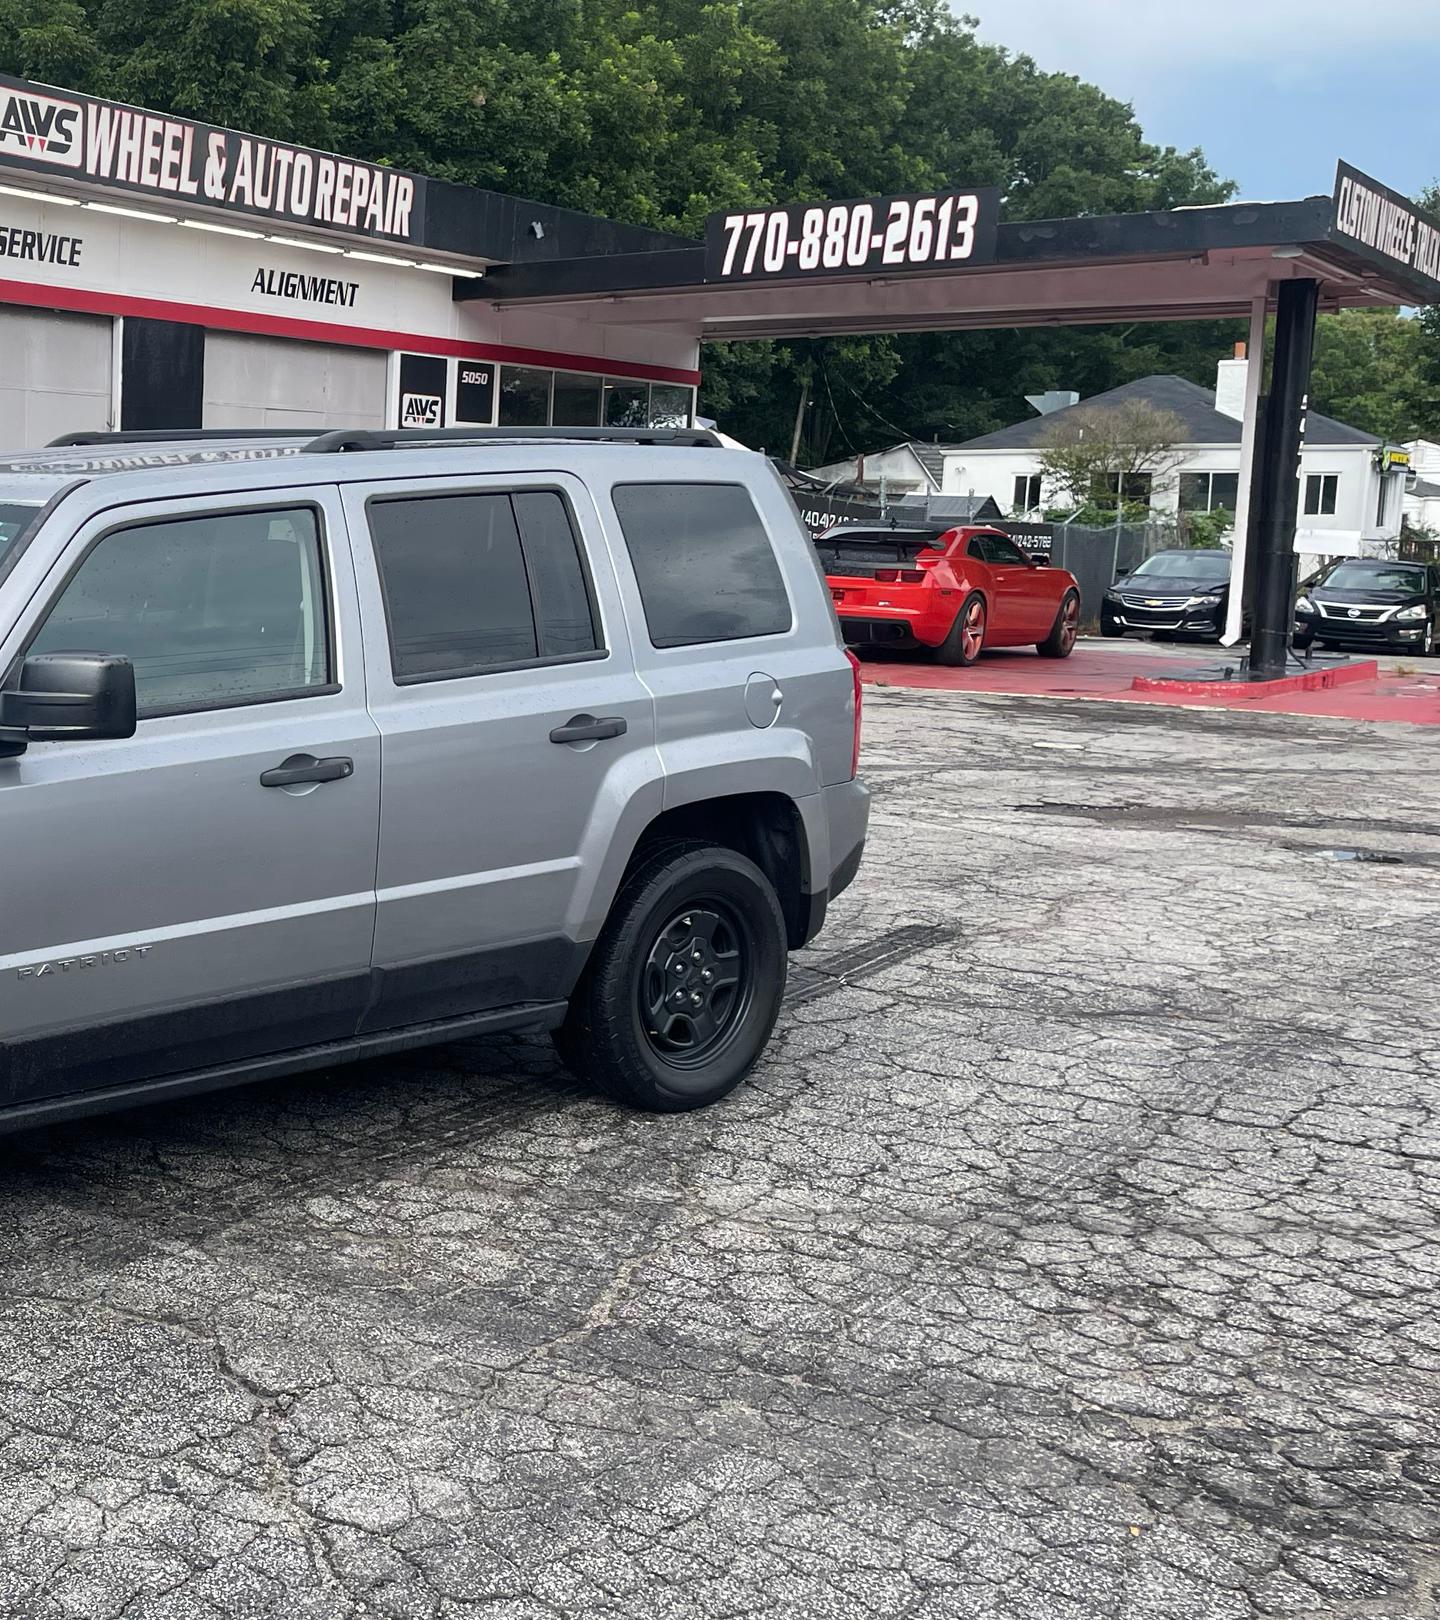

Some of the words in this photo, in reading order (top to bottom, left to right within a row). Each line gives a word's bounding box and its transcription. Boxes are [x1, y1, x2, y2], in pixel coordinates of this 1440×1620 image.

[84, 102, 198, 195] WHEEL
[204, 131, 229, 201] &
[228, 137, 312, 217] AUTO
[313, 157, 415, 238] REPAIR
[721, 194, 978, 276] 770-880-2613
[1337, 176, 1381, 247] CUSTOM
[1376, 198, 1415, 265] WHEELS
[251, 268, 359, 307] ALIGNMENT
[462, 370, 488, 385] 5050
[404, 397, 439, 424] AWS
[17, 945, 153, 980] PATRIOT
